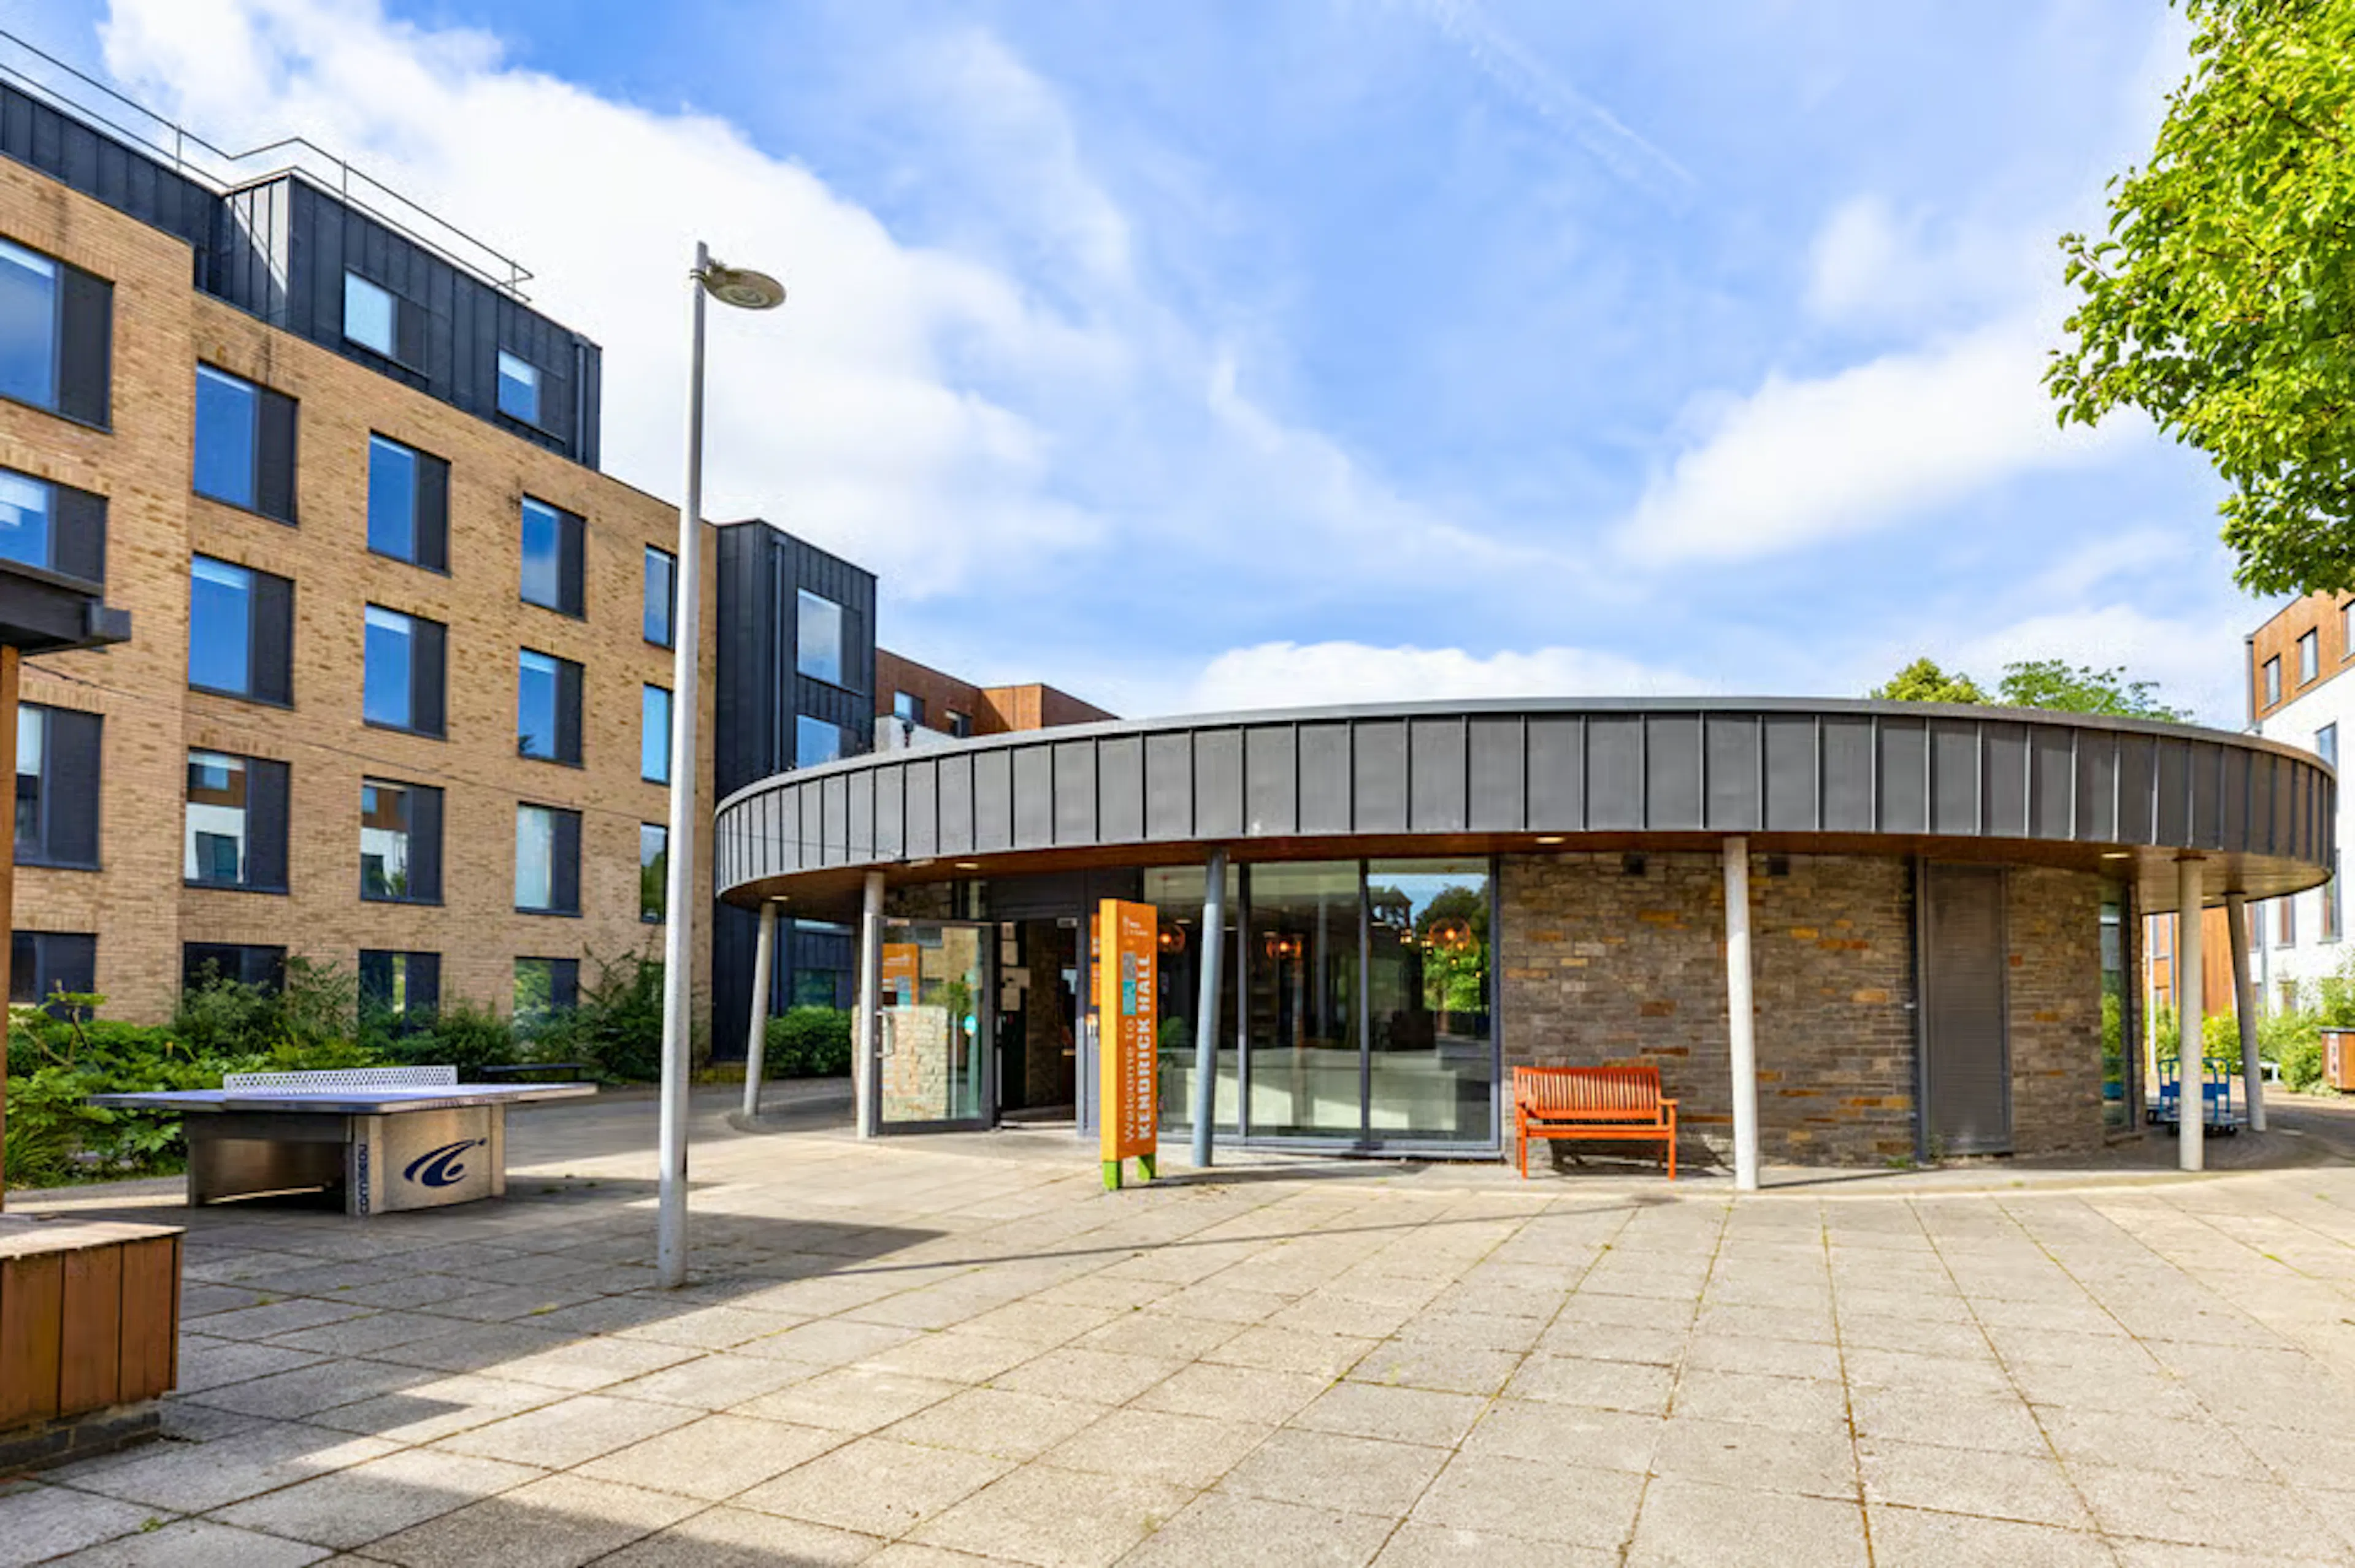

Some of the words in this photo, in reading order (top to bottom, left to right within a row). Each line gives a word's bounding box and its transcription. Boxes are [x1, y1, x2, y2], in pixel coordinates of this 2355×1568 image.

[1137, 952, 1151, 1013] HALL
[1125, 1018, 1135, 1039] to
[1125, 1045, 1135, 1144] Welcome
[1137, 1017, 1151, 1140] KENDRICK
